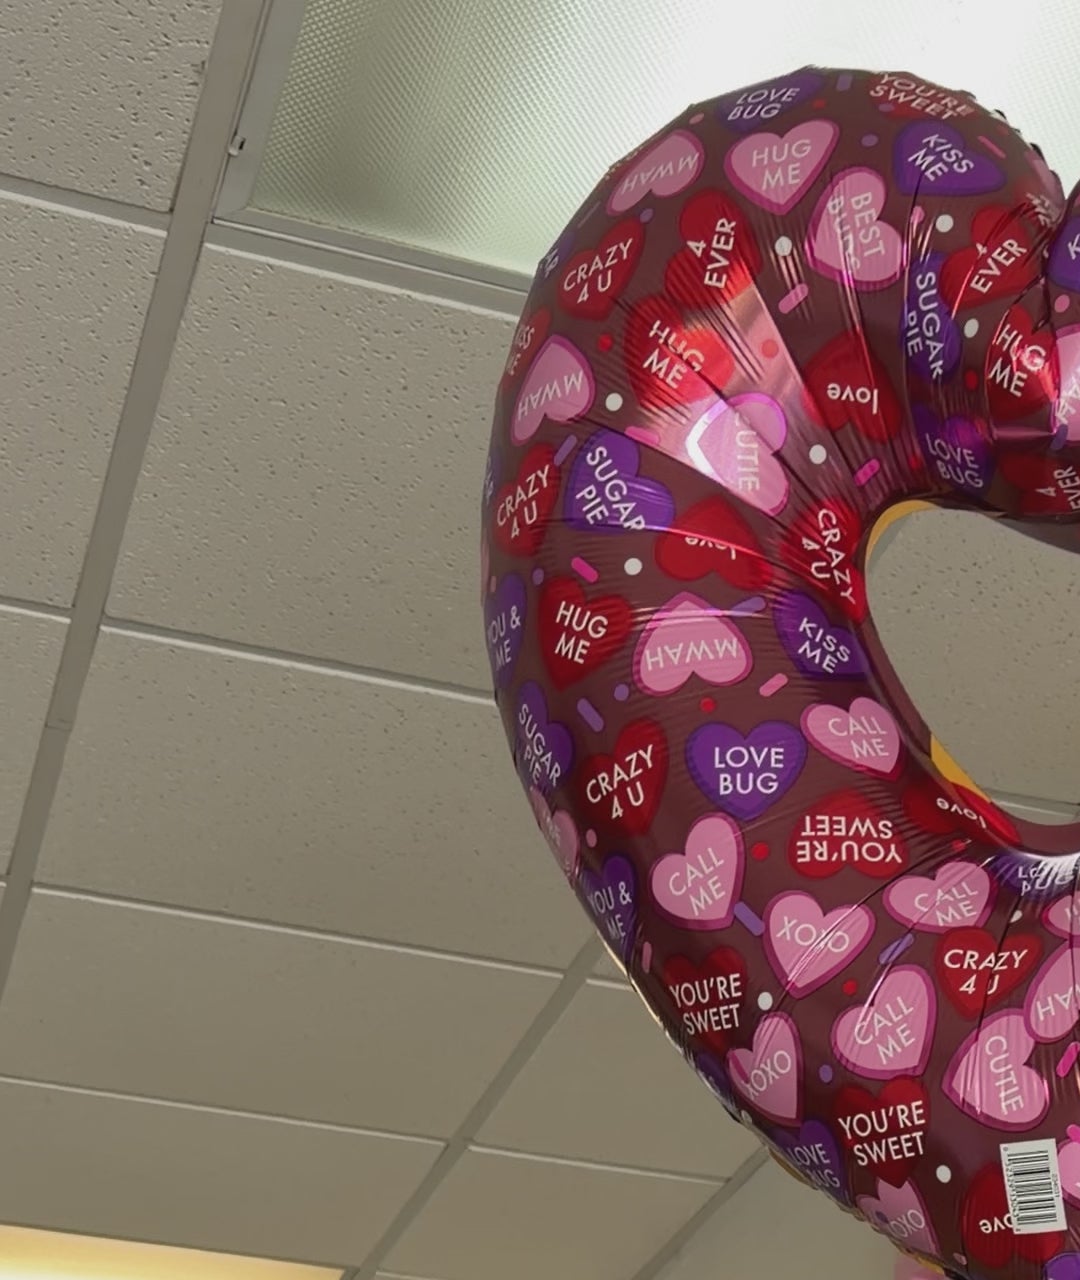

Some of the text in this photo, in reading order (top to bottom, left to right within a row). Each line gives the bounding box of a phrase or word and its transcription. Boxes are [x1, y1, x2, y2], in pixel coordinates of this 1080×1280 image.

[728, 103, 782, 121] BUG
[736, 87, 800, 106] LOVE
[869, 85, 958, 120] SWEET
[751, 139, 812, 168] HUG
[907, 147, 948, 181] ME
[922, 134, 974, 173] KISS
[619, 152, 700, 197] MWAH
[761, 164, 802, 191] ME
[850, 191, 886, 259] BEST
[563, 238, 633, 292] CRAZY
[686, 239, 705, 257] 4
[705, 218, 737, 289] EVER
[970, 238, 1027, 294] EVER
[577, 271, 613, 303] 4 U
[649, 319, 705, 372] HUG
[905, 302, 923, 357] PIE
[995, 324, 1047, 371] HUG
[643, 348, 688, 389] ME
[987, 363, 1026, 398] ME
[516, 370, 584, 422] MWAH
[826, 382, 878, 415] love
[925, 432, 977, 469] LOVE
[585, 446, 646, 532] SUGAR
[937, 455, 985, 489] BUG
[496, 465, 550, 526] CRAZY
[575, 485, 609, 526] PIE
[1036, 487, 1057, 498] 4
[511, 501, 538, 540] 4 U
[810, 563, 830, 579] U
[817, 508, 856, 605] CRAZY
[510, 605, 521, 629] &
[556, 600, 608, 640] HUG
[554, 633, 590, 664] ME
[645, 637, 739, 672] MWAH
[798, 641, 836, 674] ME
[799, 618, 850, 663] KISS
[828, 716, 887, 737] CALL
[518, 703, 561, 795] SUGAR
[523, 748, 541, 781] PIE
[714, 747, 785, 770] LOVE
[851, 739, 889, 759] ME
[586, 745, 654, 804] CRAZY
[719, 773, 779, 796] BUG
[611, 782, 644, 820] 4 U
[936, 797, 987, 829] love
[801, 815, 893, 838] SWEET
[797, 840, 903, 863] YOU'RE
[669, 847, 725, 898] CALL
[587, 881, 633, 916] YOU &
[690, 875, 726, 916] ME
[914, 881, 979, 914] CALL
[606, 913, 627, 941] ME
[935, 904, 977, 927] ME
[776, 916, 850, 954] XOXO
[944, 948, 1028, 971] CRAZY
[670, 973, 743, 1009] YOU'RE
[959, 975, 976, 994] 4
[683, 1004, 741, 1037] SWEET
[854, 996, 914, 1046] CALL
[876, 1024, 916, 1065] ME
[985, 1036, 1024, 1116] CUTIE
[838, 1100, 926, 1141] YOU'RE
[853, 1132, 924, 1166] SWEET
